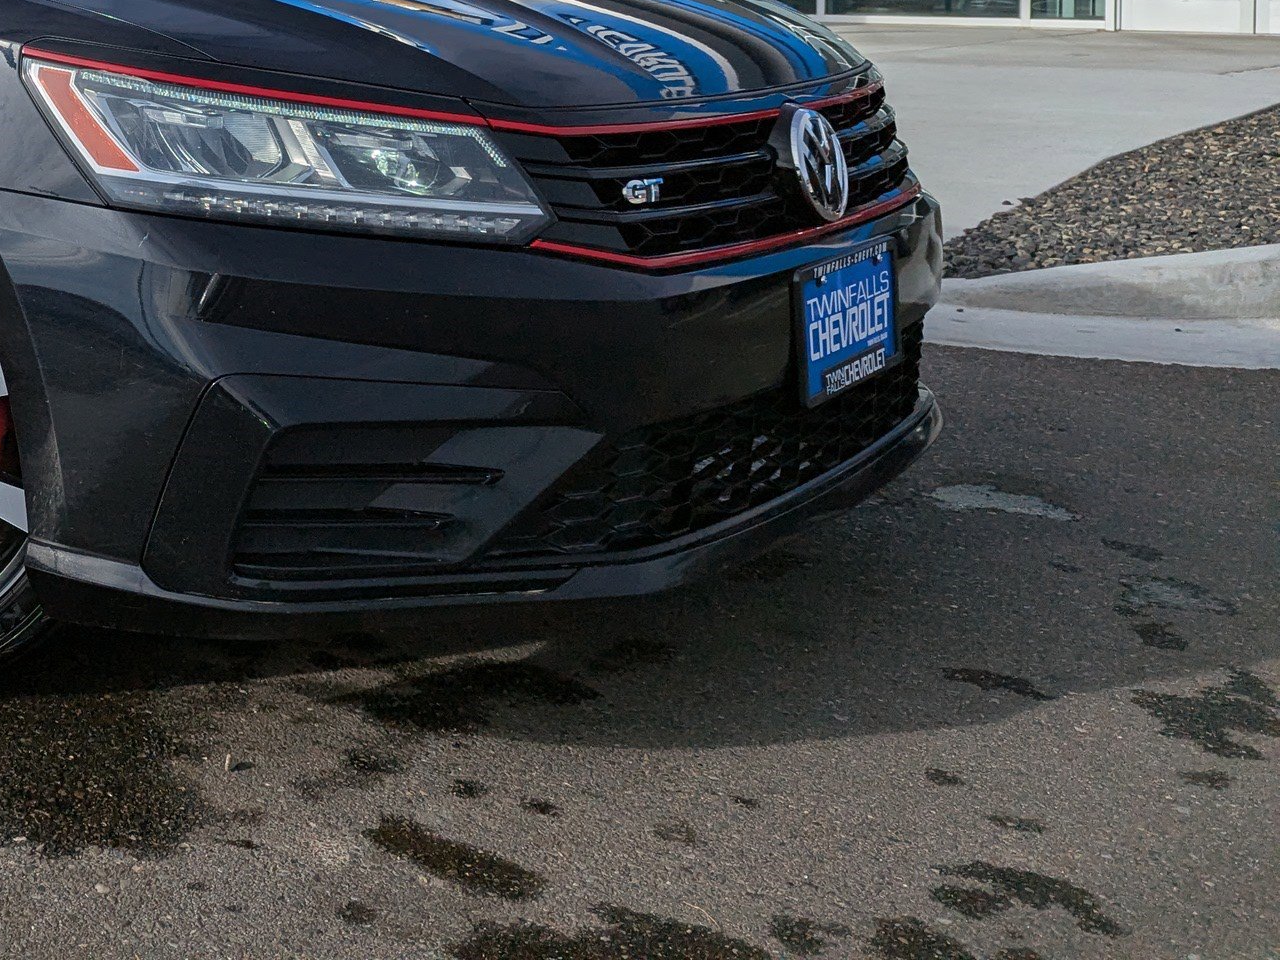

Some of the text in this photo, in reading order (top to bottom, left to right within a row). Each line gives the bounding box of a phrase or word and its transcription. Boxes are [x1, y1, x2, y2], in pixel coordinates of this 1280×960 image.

[621, 177, 664, 205] GT
[807, 270, 890, 322] TWINFALLS
[809, 291, 890, 362] CHEVROLET
[825, 367, 845, 387] TWIN
[844, 348, 886, 386] CHEVROLET
[826, 378, 845, 396] FALLS
